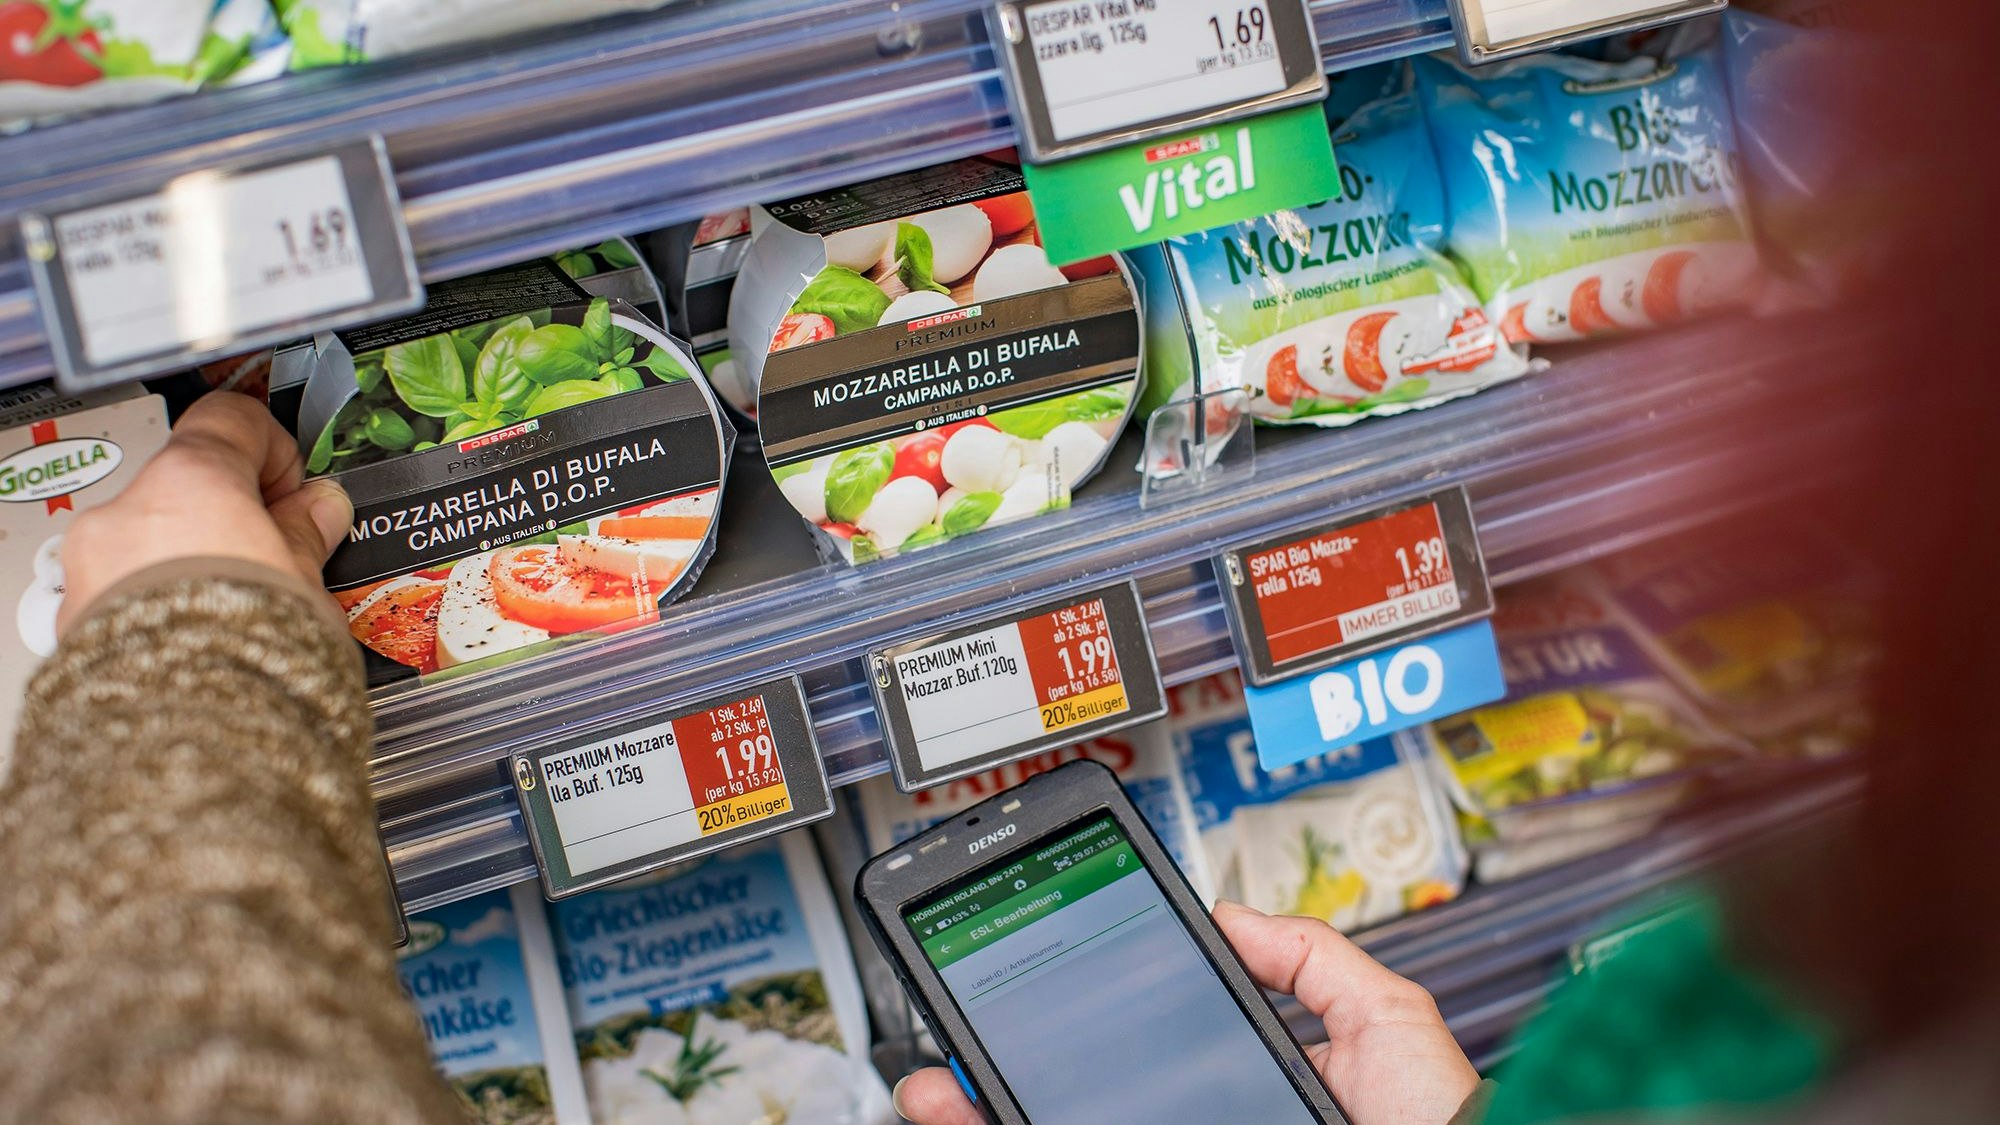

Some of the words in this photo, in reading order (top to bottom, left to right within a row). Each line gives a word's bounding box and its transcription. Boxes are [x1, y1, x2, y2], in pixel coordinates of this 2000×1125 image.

[1029, 6, 1093, 35] DESPAR
[1110, 22, 1147, 45] 125g
[1208, 7, 1265, 50] 1.69
[1118, 126, 1256, 235] Vital
[277, 206, 348, 266] 1.69
[895, 317, 997, 351] PREMIUM
[915, 309, 968, 329] DESPAR
[813, 355, 962, 408] MOZZARELLA
[967, 346, 990, 370] DI
[997, 328, 1081, 364] BUFALA
[883, 380, 963, 411] CAMPANA
[967, 366, 1016, 390] D.O.P.
[926, 415, 945, 428] AUS
[945, 406, 976, 424] ITALIEN
[446, 430, 557, 475] PREMIUM
[469, 425, 527, 450] DESPAR
[0, 443, 110, 496] GIOIELLA
[349, 476, 527, 544] MOZZARELLA
[531, 464, 559, 491] DI
[564, 437, 667, 483] BUFALA
[406, 498, 536, 552] CAMPANA
[541, 474, 617, 514] D.O.P.
[492, 532, 512, 547] AUS
[511, 522, 546, 543] ITALIEN
[1250, 553, 1288, 579] SPAR
[1288, 545, 1310, 567] Bio
[1309, 535, 1360, 561] Mozza-
[1394, 535, 1447, 580] 1.39
[1256, 574, 1288, 599] rella
[1288, 565, 1322, 590] 125g
[1406, 577, 1421, 595] kg
[1051, 613, 1059, 627] 1
[1059, 608, 1081, 625] Stk.
[1080, 601, 1102, 620] 2.49
[1053, 630, 1067, 645] ab
[1067, 627, 1076, 641] 2
[1075, 622, 1096, 639] Stk.
[1095, 618, 1107, 638] je
[1343, 605, 1400, 637] IMMER
[1402, 588, 1456, 619] BILLIG
[899, 647, 966, 681] PREMIUM
[967, 635, 997, 659] Mini
[1058, 635, 1112, 681] 1.99
[1047, 685, 1070, 702] (per
[1070, 680, 1085, 696] kg
[1085, 668, 1120, 689] 16.58)
[1308, 644, 1444, 742] BIO
[709, 711, 716, 726] 1
[716, 705, 740, 724] Stk.
[740, 698, 763, 718] 2.49
[710, 728, 724, 744] ab
[724, 724, 735, 740] 2
[734, 719, 756, 737] Stk.
[756, 716, 768, 735] je
[1042, 701, 1078, 730] 20%
[1077, 695, 1125, 719] Billiger
[543, 745, 612, 781] PREMIUM
[615, 731, 676, 760] Mozzare
[714, 734, 775, 782] 1.99
[550, 784, 572, 805] lla
[574, 776, 605, 800] Buf.
[605, 764, 645, 788] 125g
[704, 784, 729, 804] (per
[728, 779, 746, 796] kg
[745, 767, 782, 788] 15.92)
[699, 802, 737, 832] 20%
[736, 796, 788, 822] Billiger
[967, 822, 1018, 855] DENSO
[950, 910, 970, 925] 63%
[1096, 833, 1120, 852] 15:51
[953, 881, 987, 903] ROLAND,
[1002, 863, 1025, 880] 2479
[969, 921, 995, 942] ESL
[994, 888, 1064, 929] Bearbeitung
[1008, 937, 1065, 972] Artikelnummer
